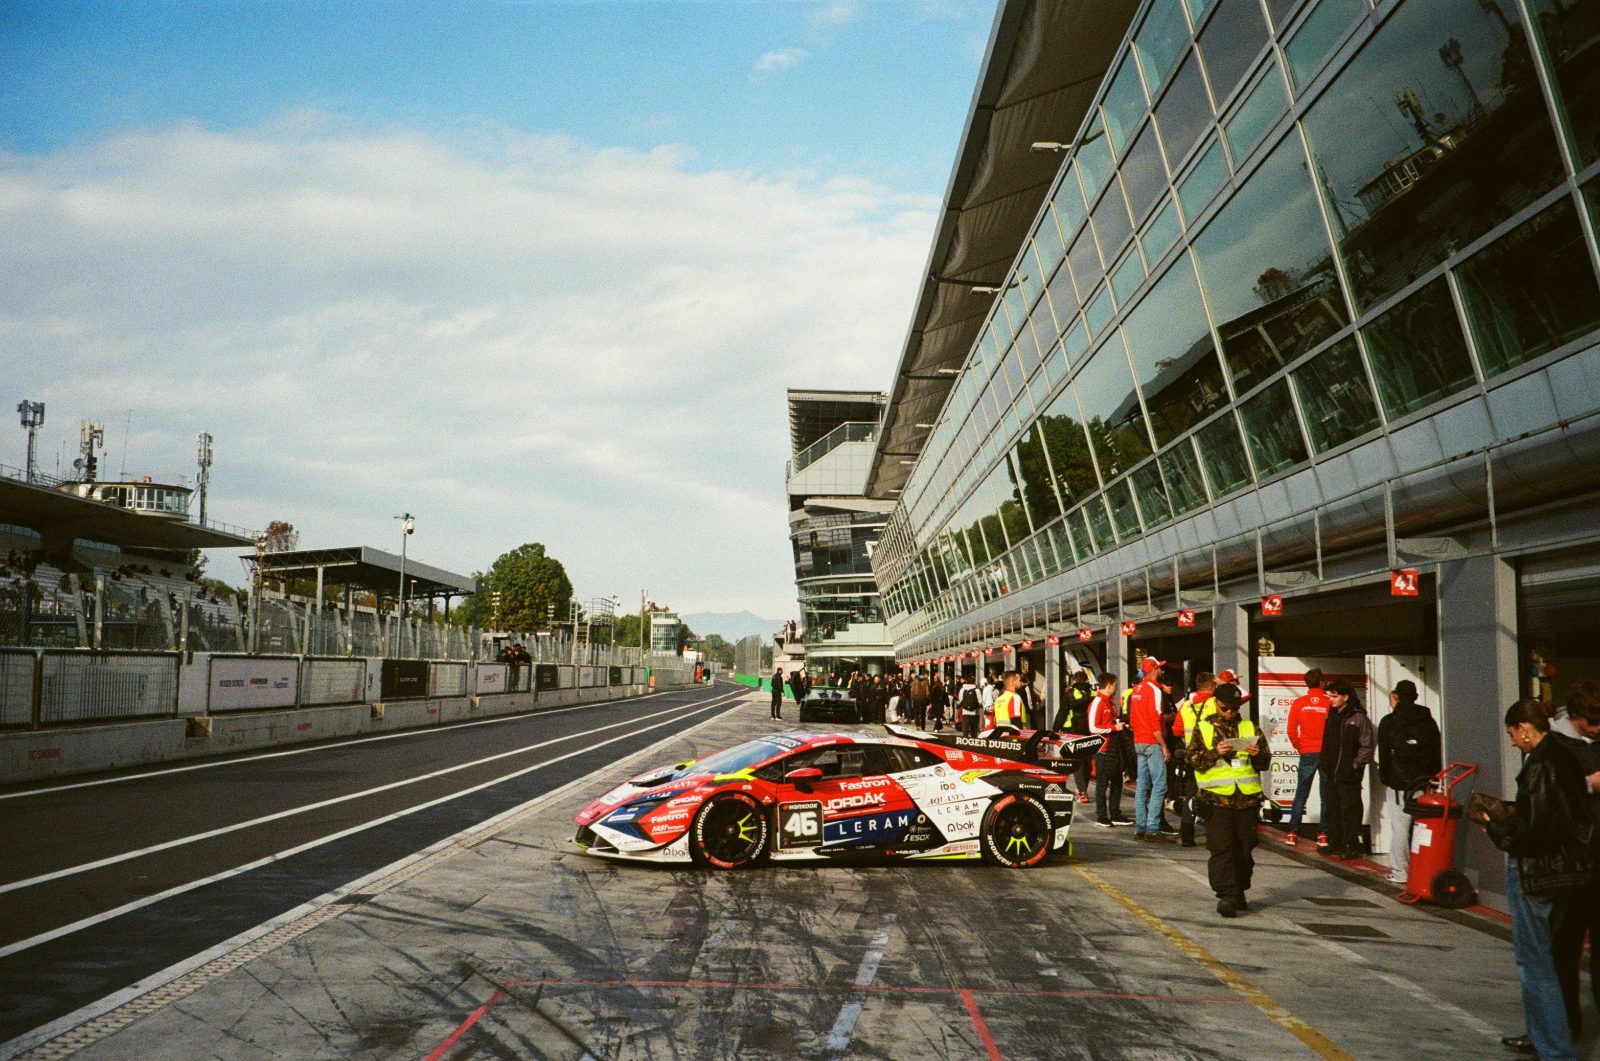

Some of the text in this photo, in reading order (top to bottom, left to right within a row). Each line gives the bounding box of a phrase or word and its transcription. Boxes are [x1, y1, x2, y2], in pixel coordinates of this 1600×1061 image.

[1394, 575, 1415, 591] 41
[1264, 598, 1281, 611] 42
[1179, 612, 1193, 623] 43
[956, 737, 1021, 750] ROGER DUBUIS
[1076, 738, 1102, 750] macron
[839, 779, 891, 791] Fastron
[651, 812, 689, 824] Fastron
[784, 811, 818, 837] 46
[839, 814, 908, 835] LERAM
